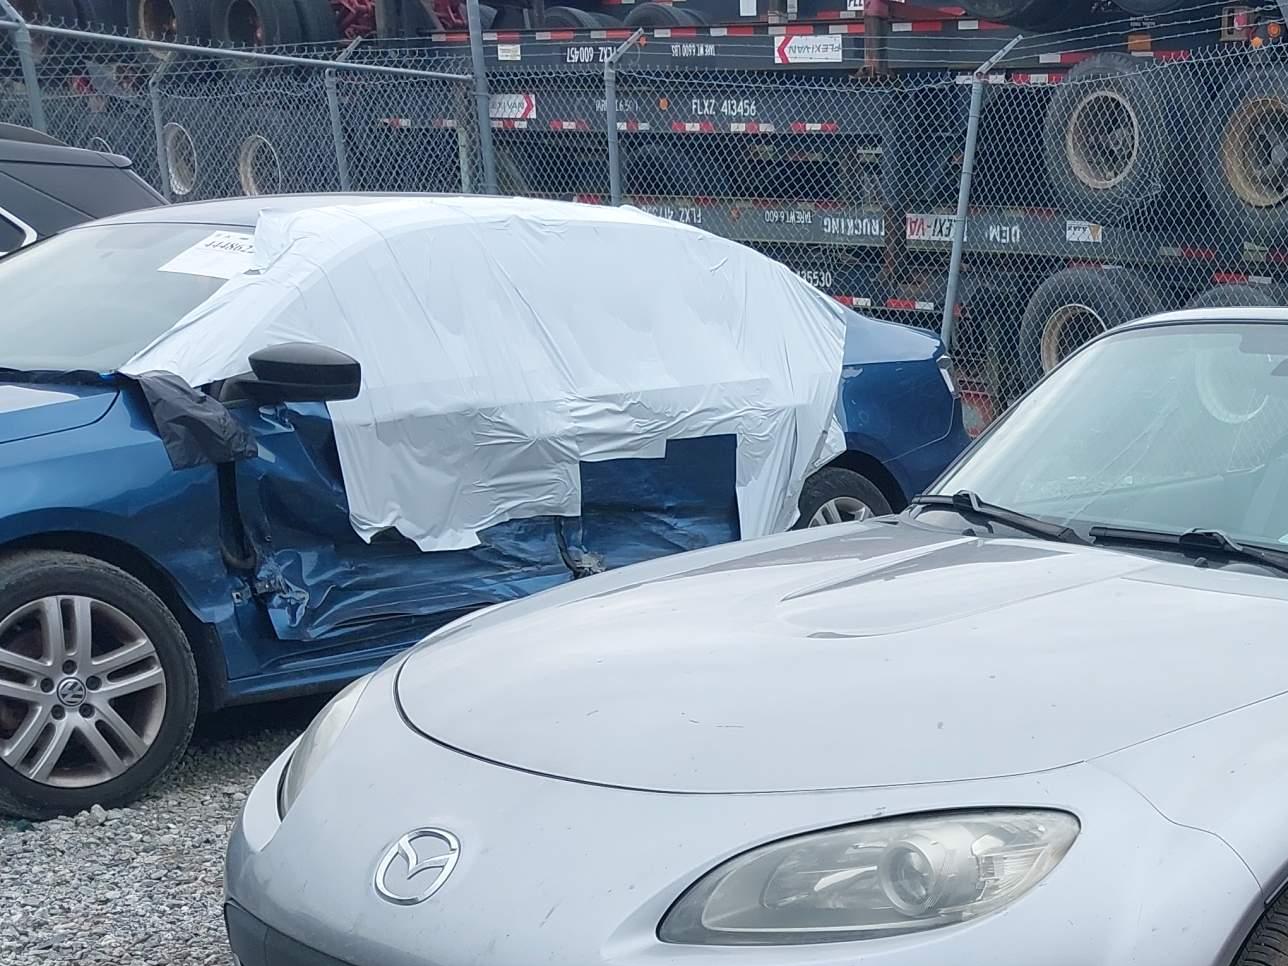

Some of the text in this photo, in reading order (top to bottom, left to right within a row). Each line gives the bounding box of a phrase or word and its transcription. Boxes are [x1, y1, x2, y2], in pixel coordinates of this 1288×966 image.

[567, 47, 594, 62] 600457
[691, 99, 757, 116] FLXZ 413456
[823, 217, 886, 236] TRUCKING
